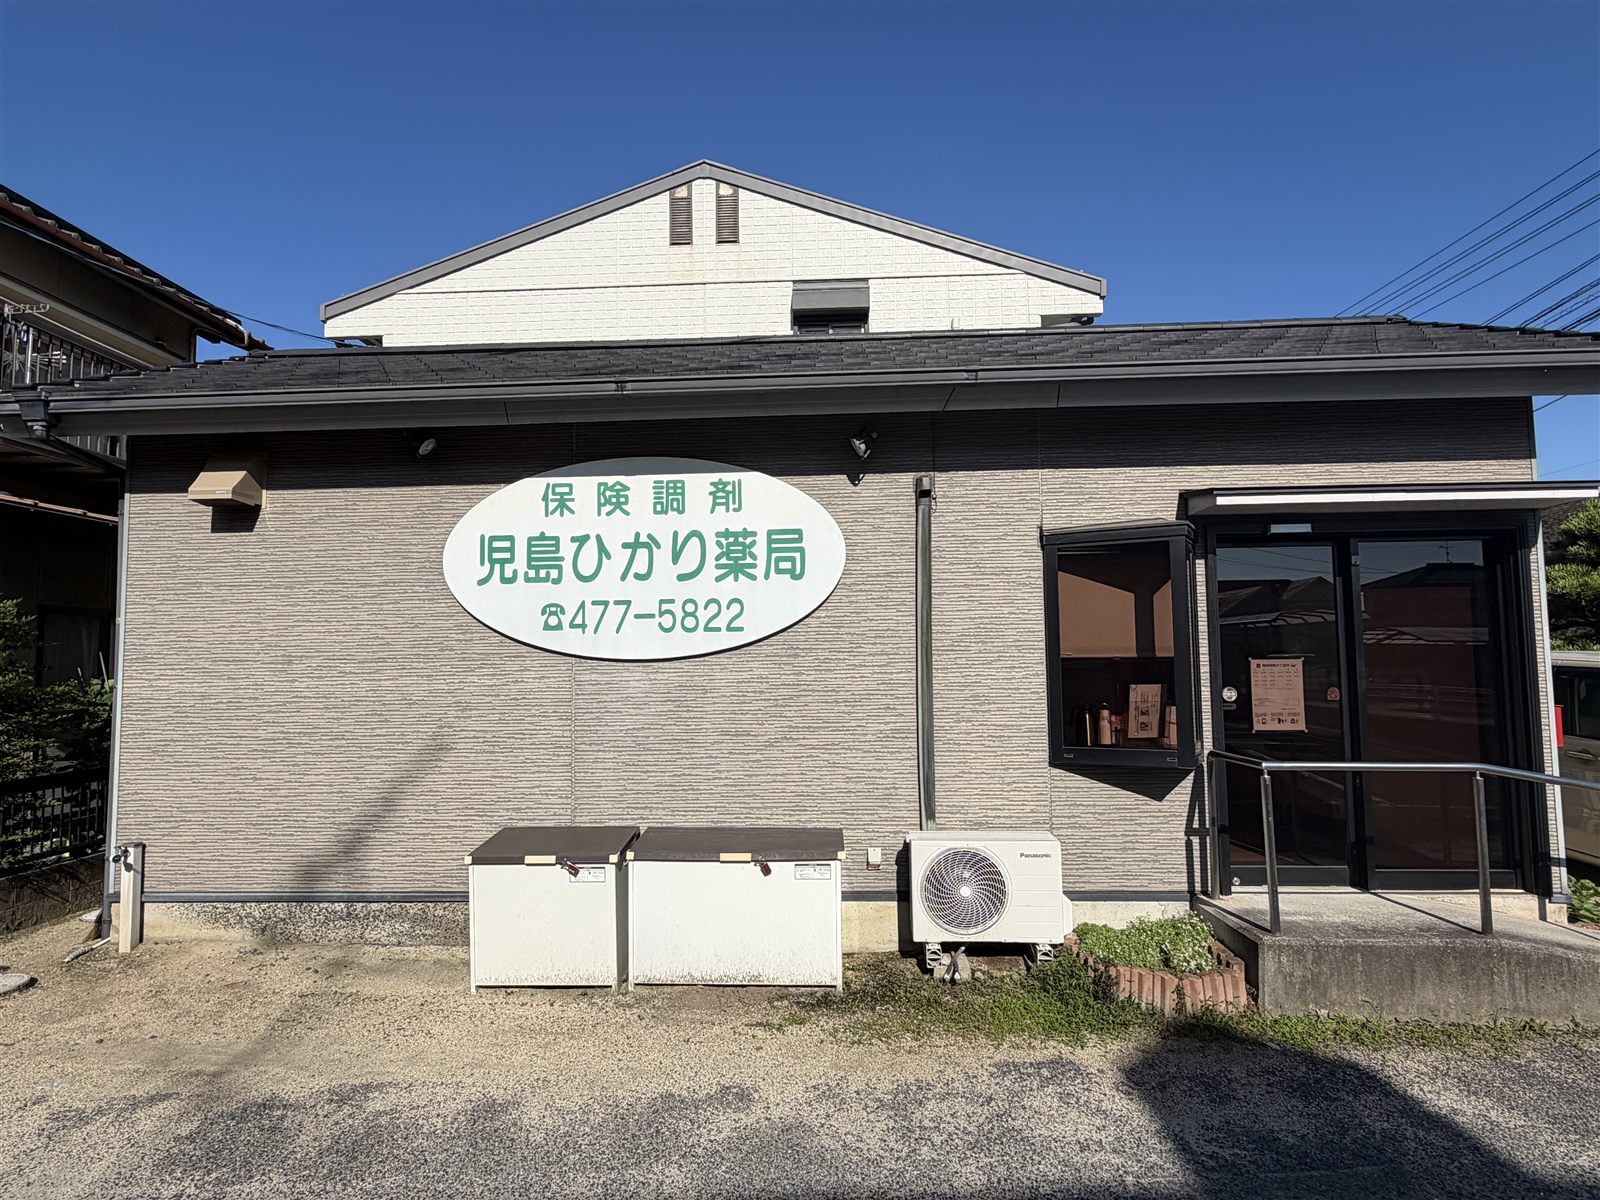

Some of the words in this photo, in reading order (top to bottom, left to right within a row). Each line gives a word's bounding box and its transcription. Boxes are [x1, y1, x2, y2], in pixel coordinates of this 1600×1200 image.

[541, 478, 742, 517] 保険調剤
[477, 527, 806, 586] 児島ひかり薬局
[568, 597, 745, 634] 477-5822
